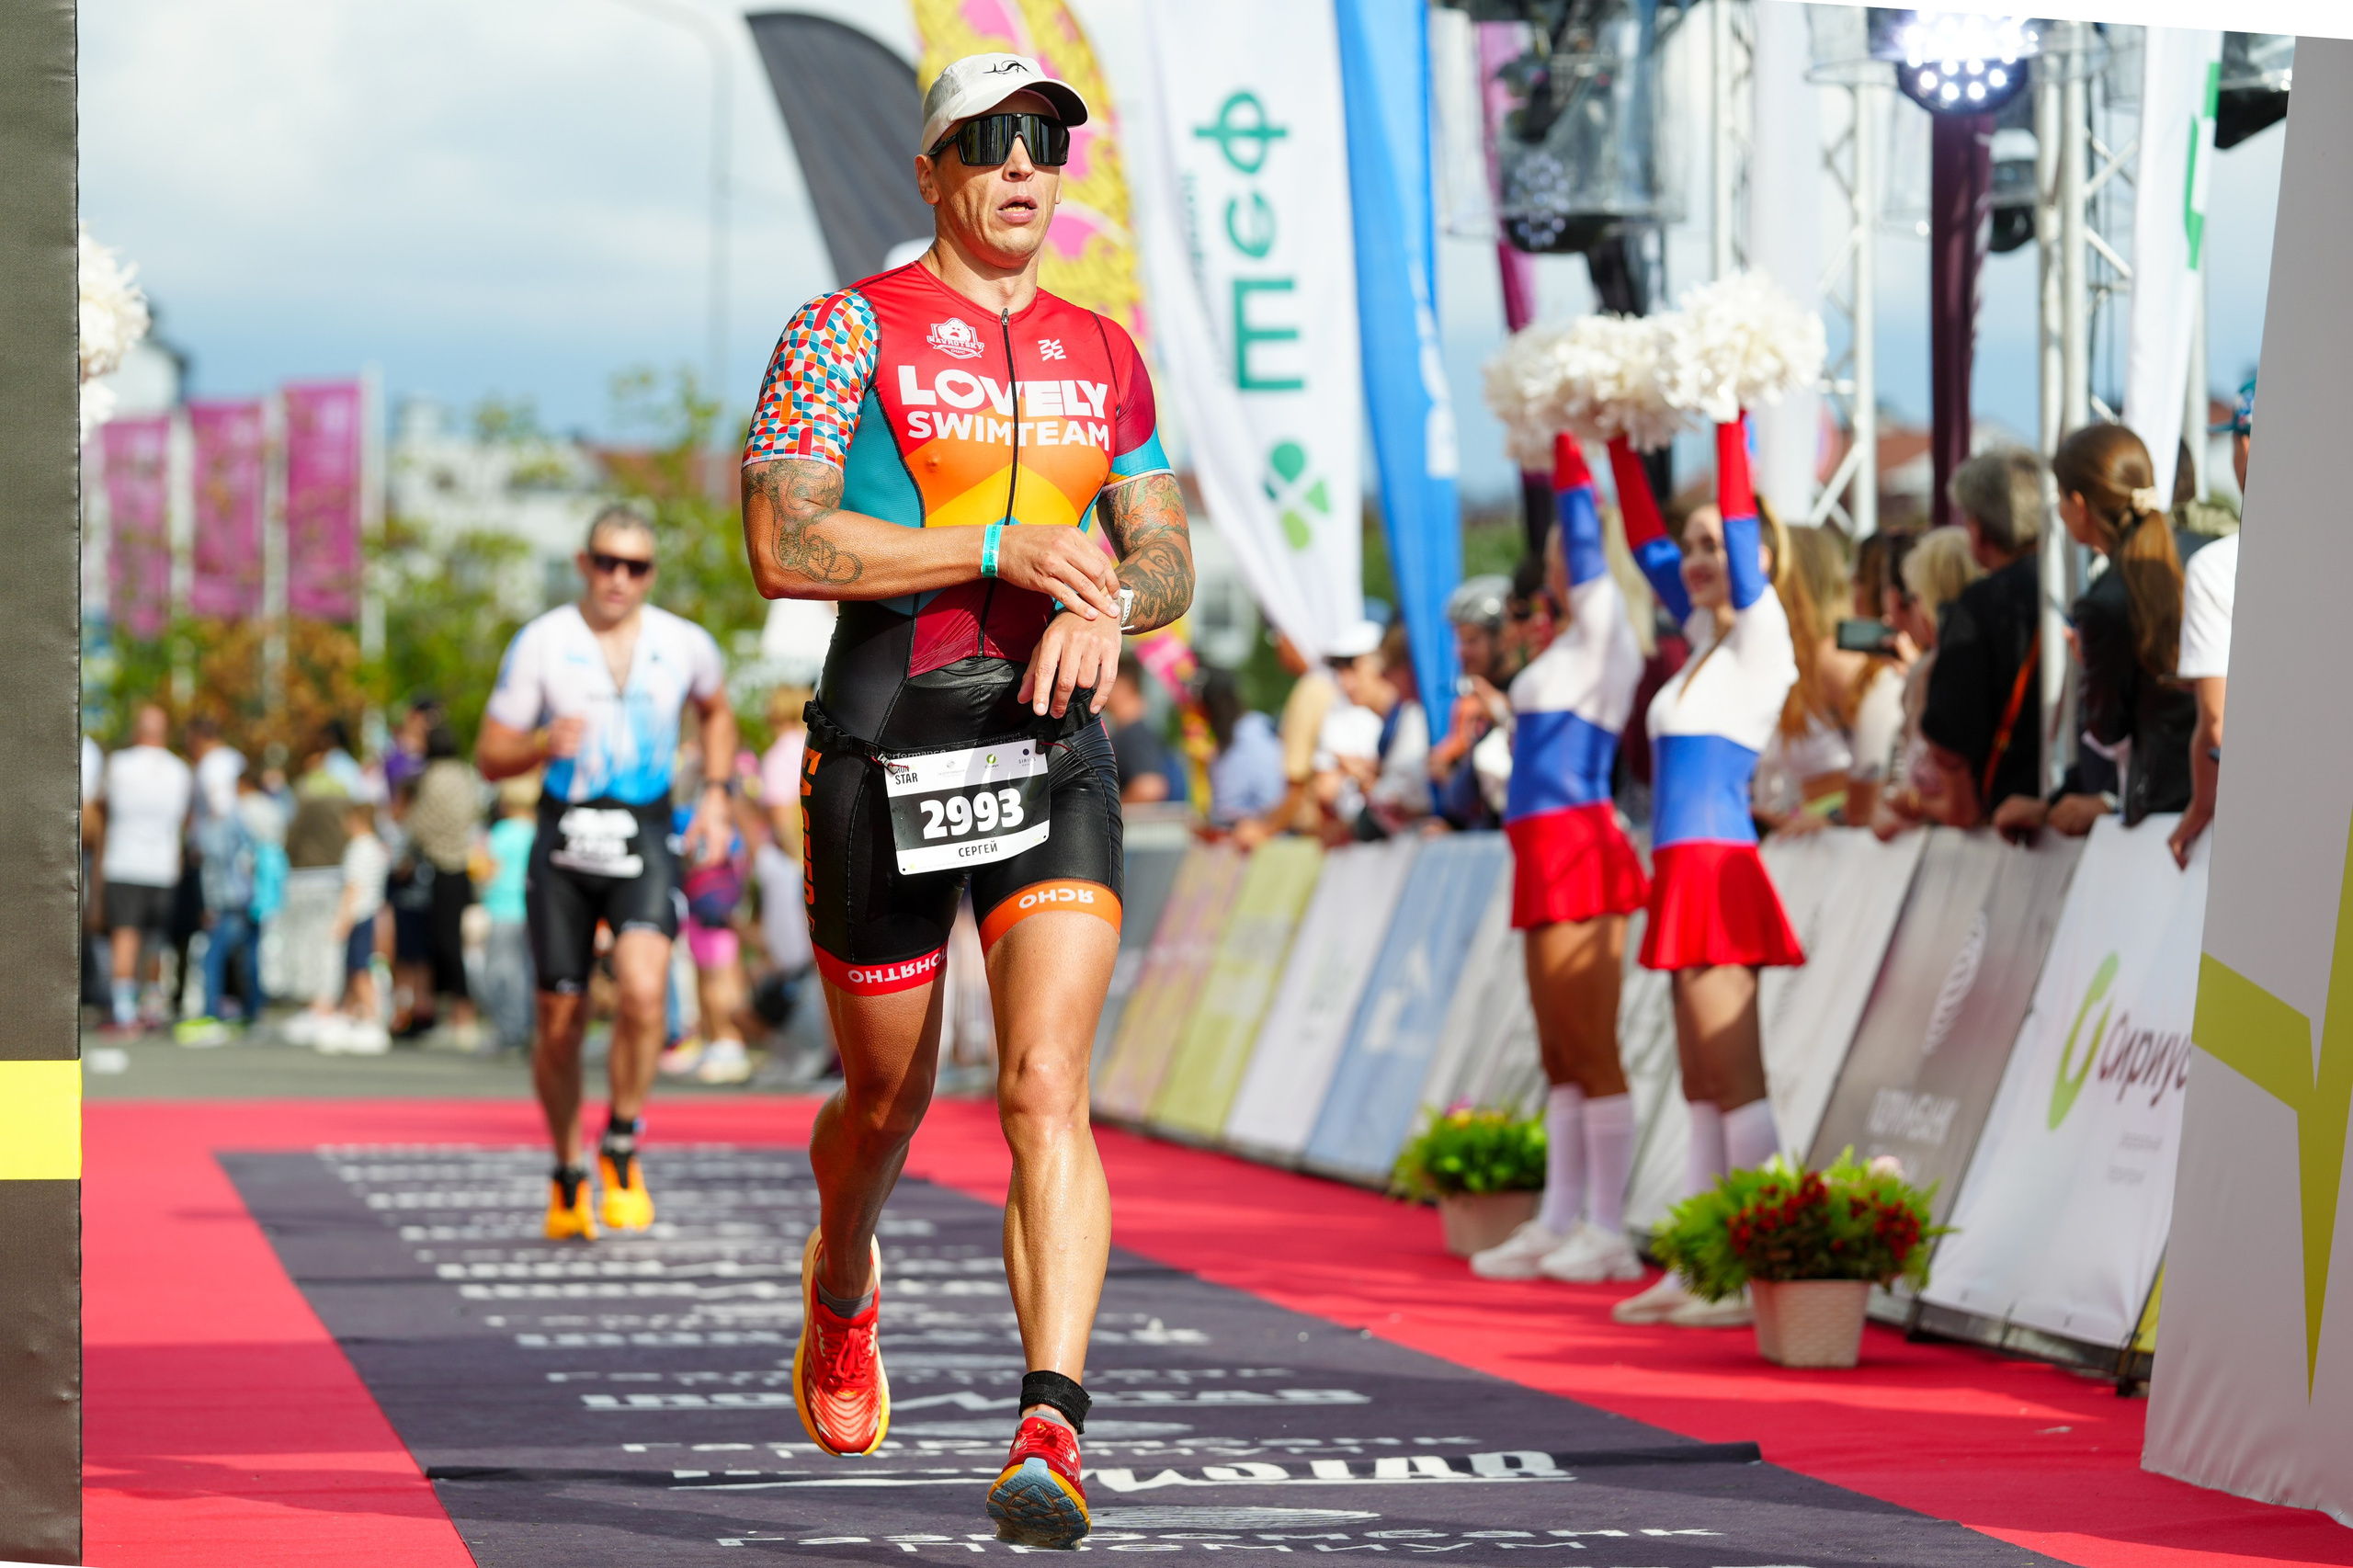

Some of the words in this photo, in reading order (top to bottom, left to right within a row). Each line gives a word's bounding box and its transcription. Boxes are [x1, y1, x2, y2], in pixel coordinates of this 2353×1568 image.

[898, 365, 1108, 420] LOVELY
[907, 411, 1110, 452] SWIMTEAM
[894, 772, 918, 786] STAR
[919, 788, 1025, 840] 2993
[958, 840, 998, 858] СЕРГЕЙ
[1018, 887, 1095, 909] ЯСНО
